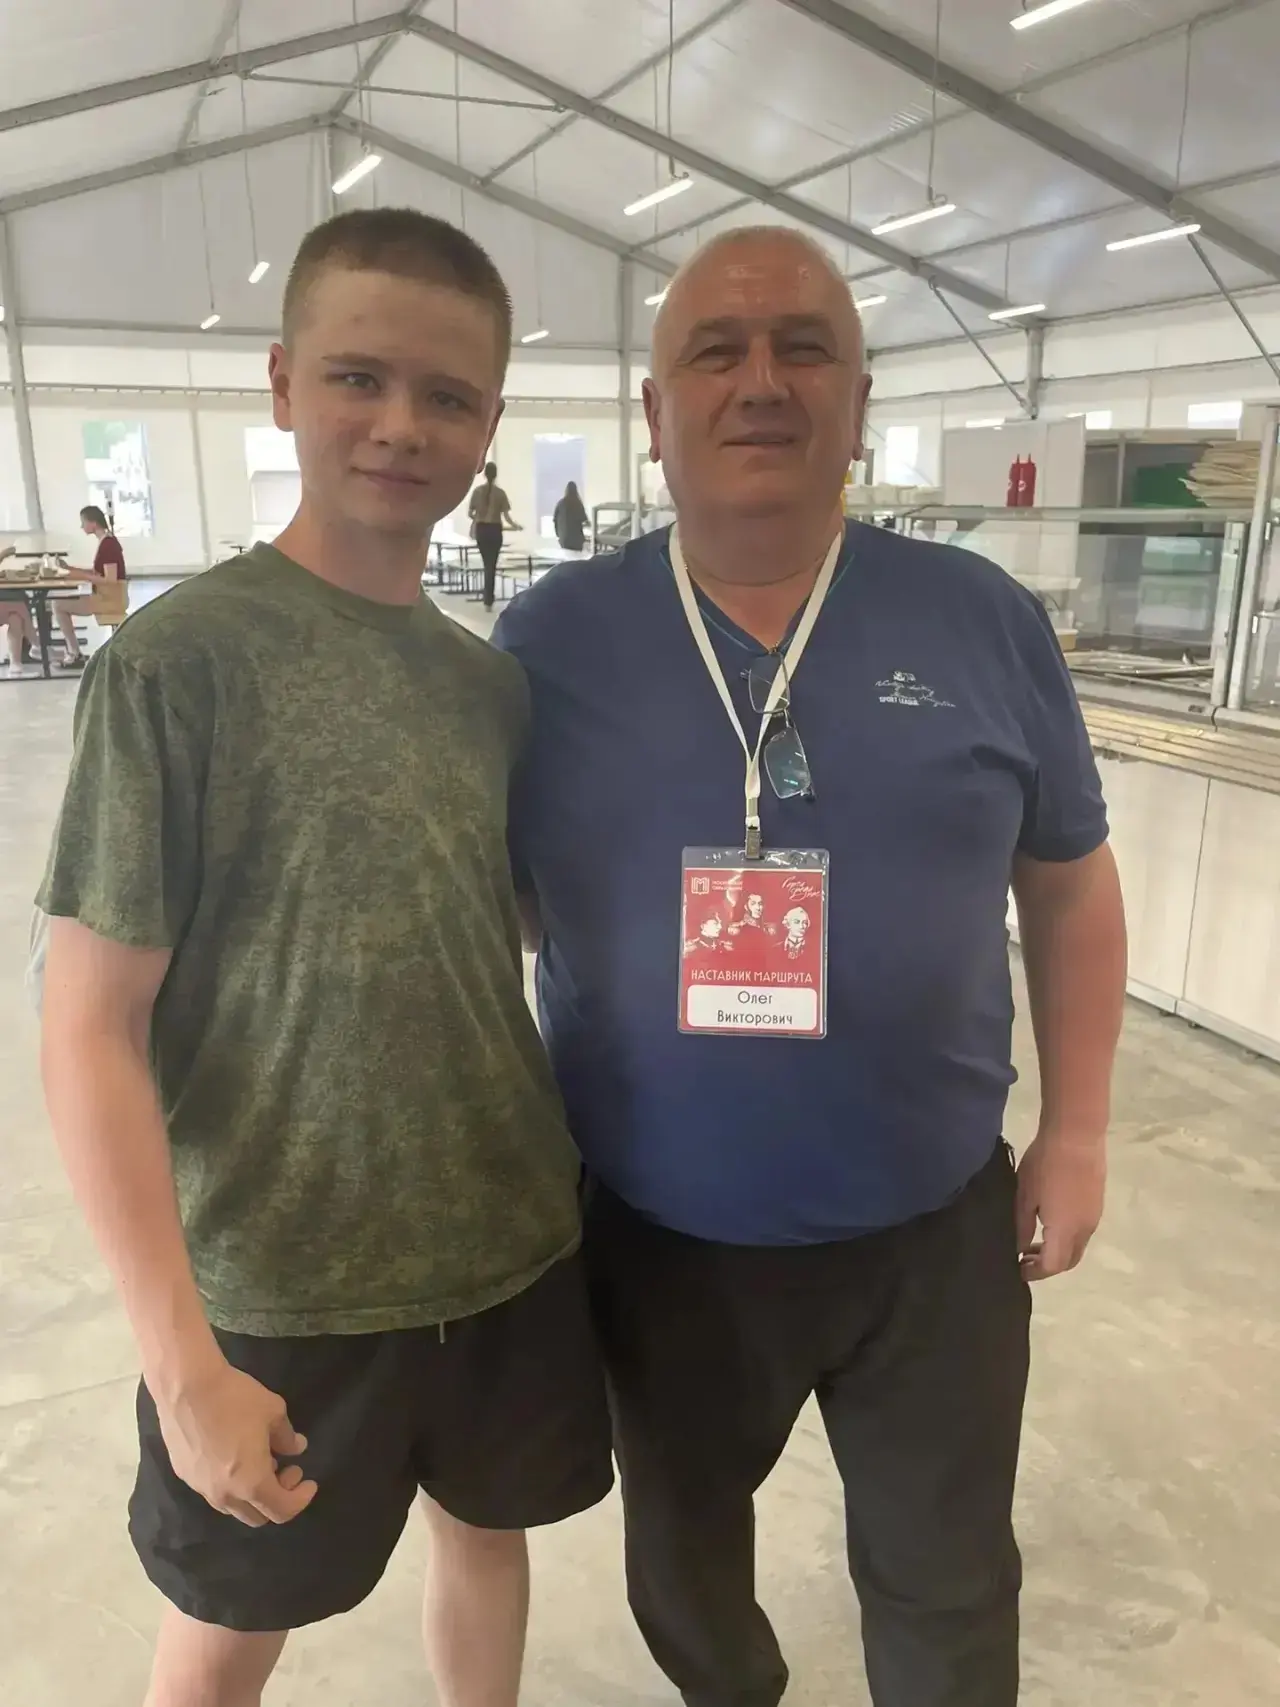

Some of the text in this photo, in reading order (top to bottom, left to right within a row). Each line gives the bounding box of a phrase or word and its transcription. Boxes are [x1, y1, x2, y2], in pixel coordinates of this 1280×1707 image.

[691, 969, 813, 984] НАСТАВНИК МАРШРУТА
[737, 990, 773, 1005] Олег
[717, 1009, 793, 1026] Викторович
